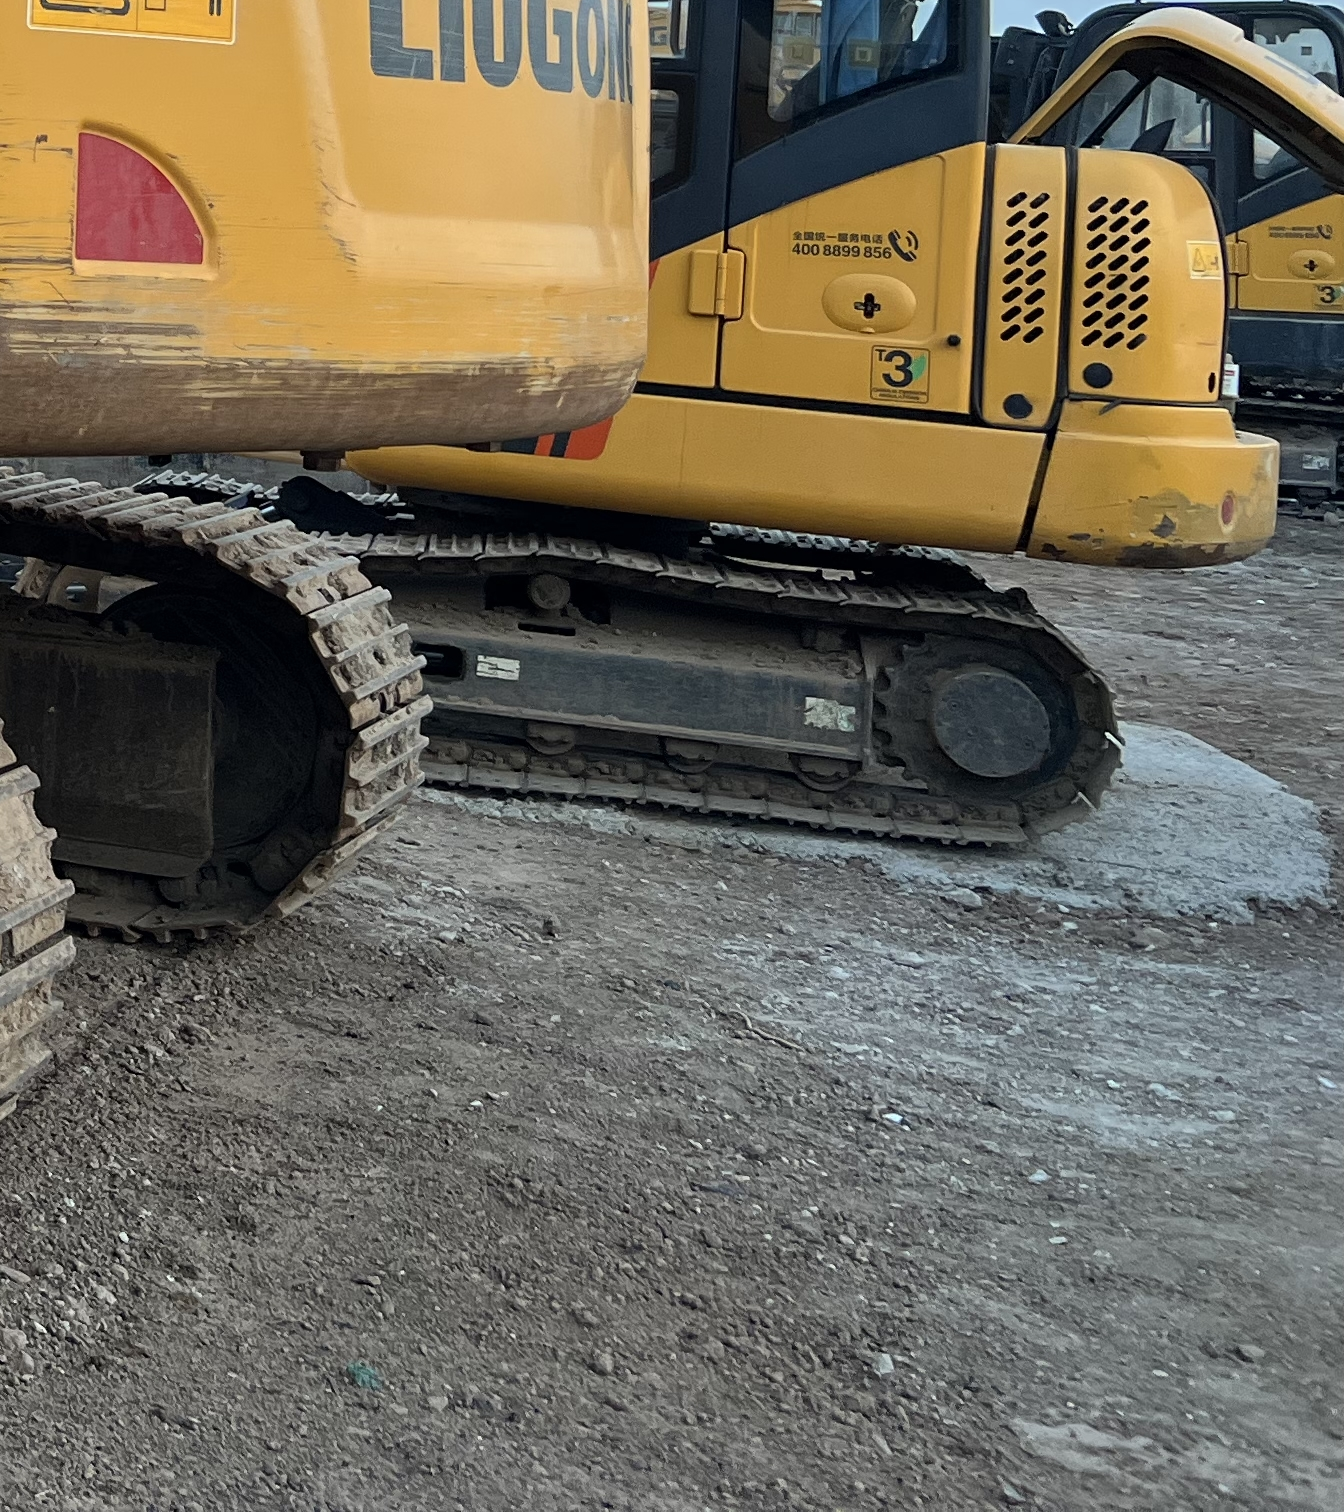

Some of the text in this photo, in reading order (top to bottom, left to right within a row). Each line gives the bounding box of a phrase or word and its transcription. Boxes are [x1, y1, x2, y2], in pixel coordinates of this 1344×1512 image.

[792, 231, 883, 245] 全国统一服务电话
[791, 243, 893, 259] 400 8899 856
